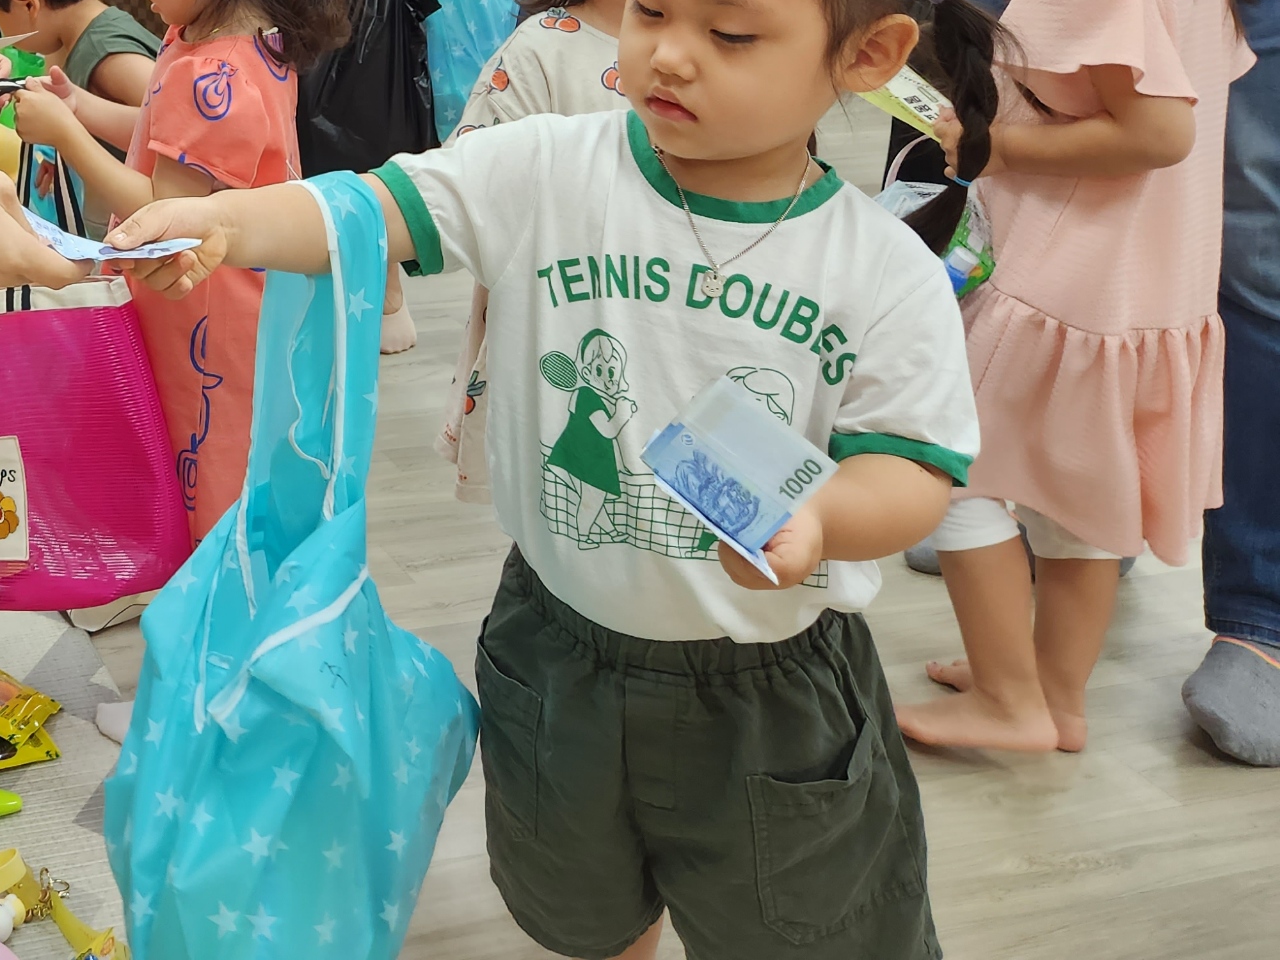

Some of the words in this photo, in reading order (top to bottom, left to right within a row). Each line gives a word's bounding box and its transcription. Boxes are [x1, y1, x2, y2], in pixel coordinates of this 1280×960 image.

[537, 254, 670, 308] TENNIS
[685, 263, 857, 386] DOUBES
[779, 459, 823, 500] 1000
